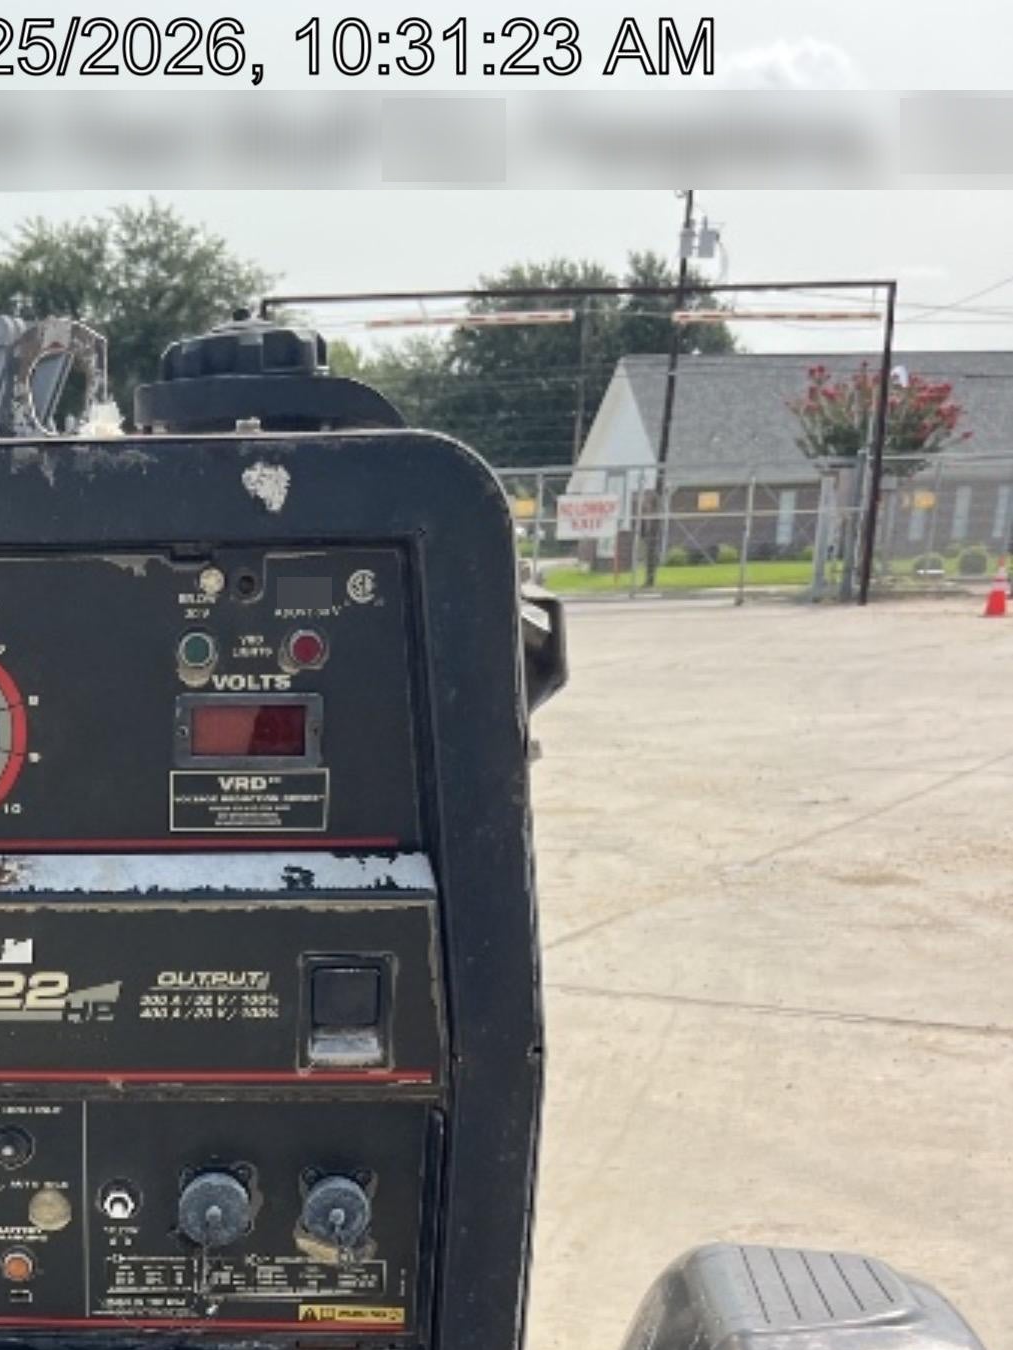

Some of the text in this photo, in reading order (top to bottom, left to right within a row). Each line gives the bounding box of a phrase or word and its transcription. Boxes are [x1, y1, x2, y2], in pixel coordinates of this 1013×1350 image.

[211, 673, 292, 690] VOLTS
[3, 803, 22, 815] 10
[156, 970, 265, 987] OUTPUT
